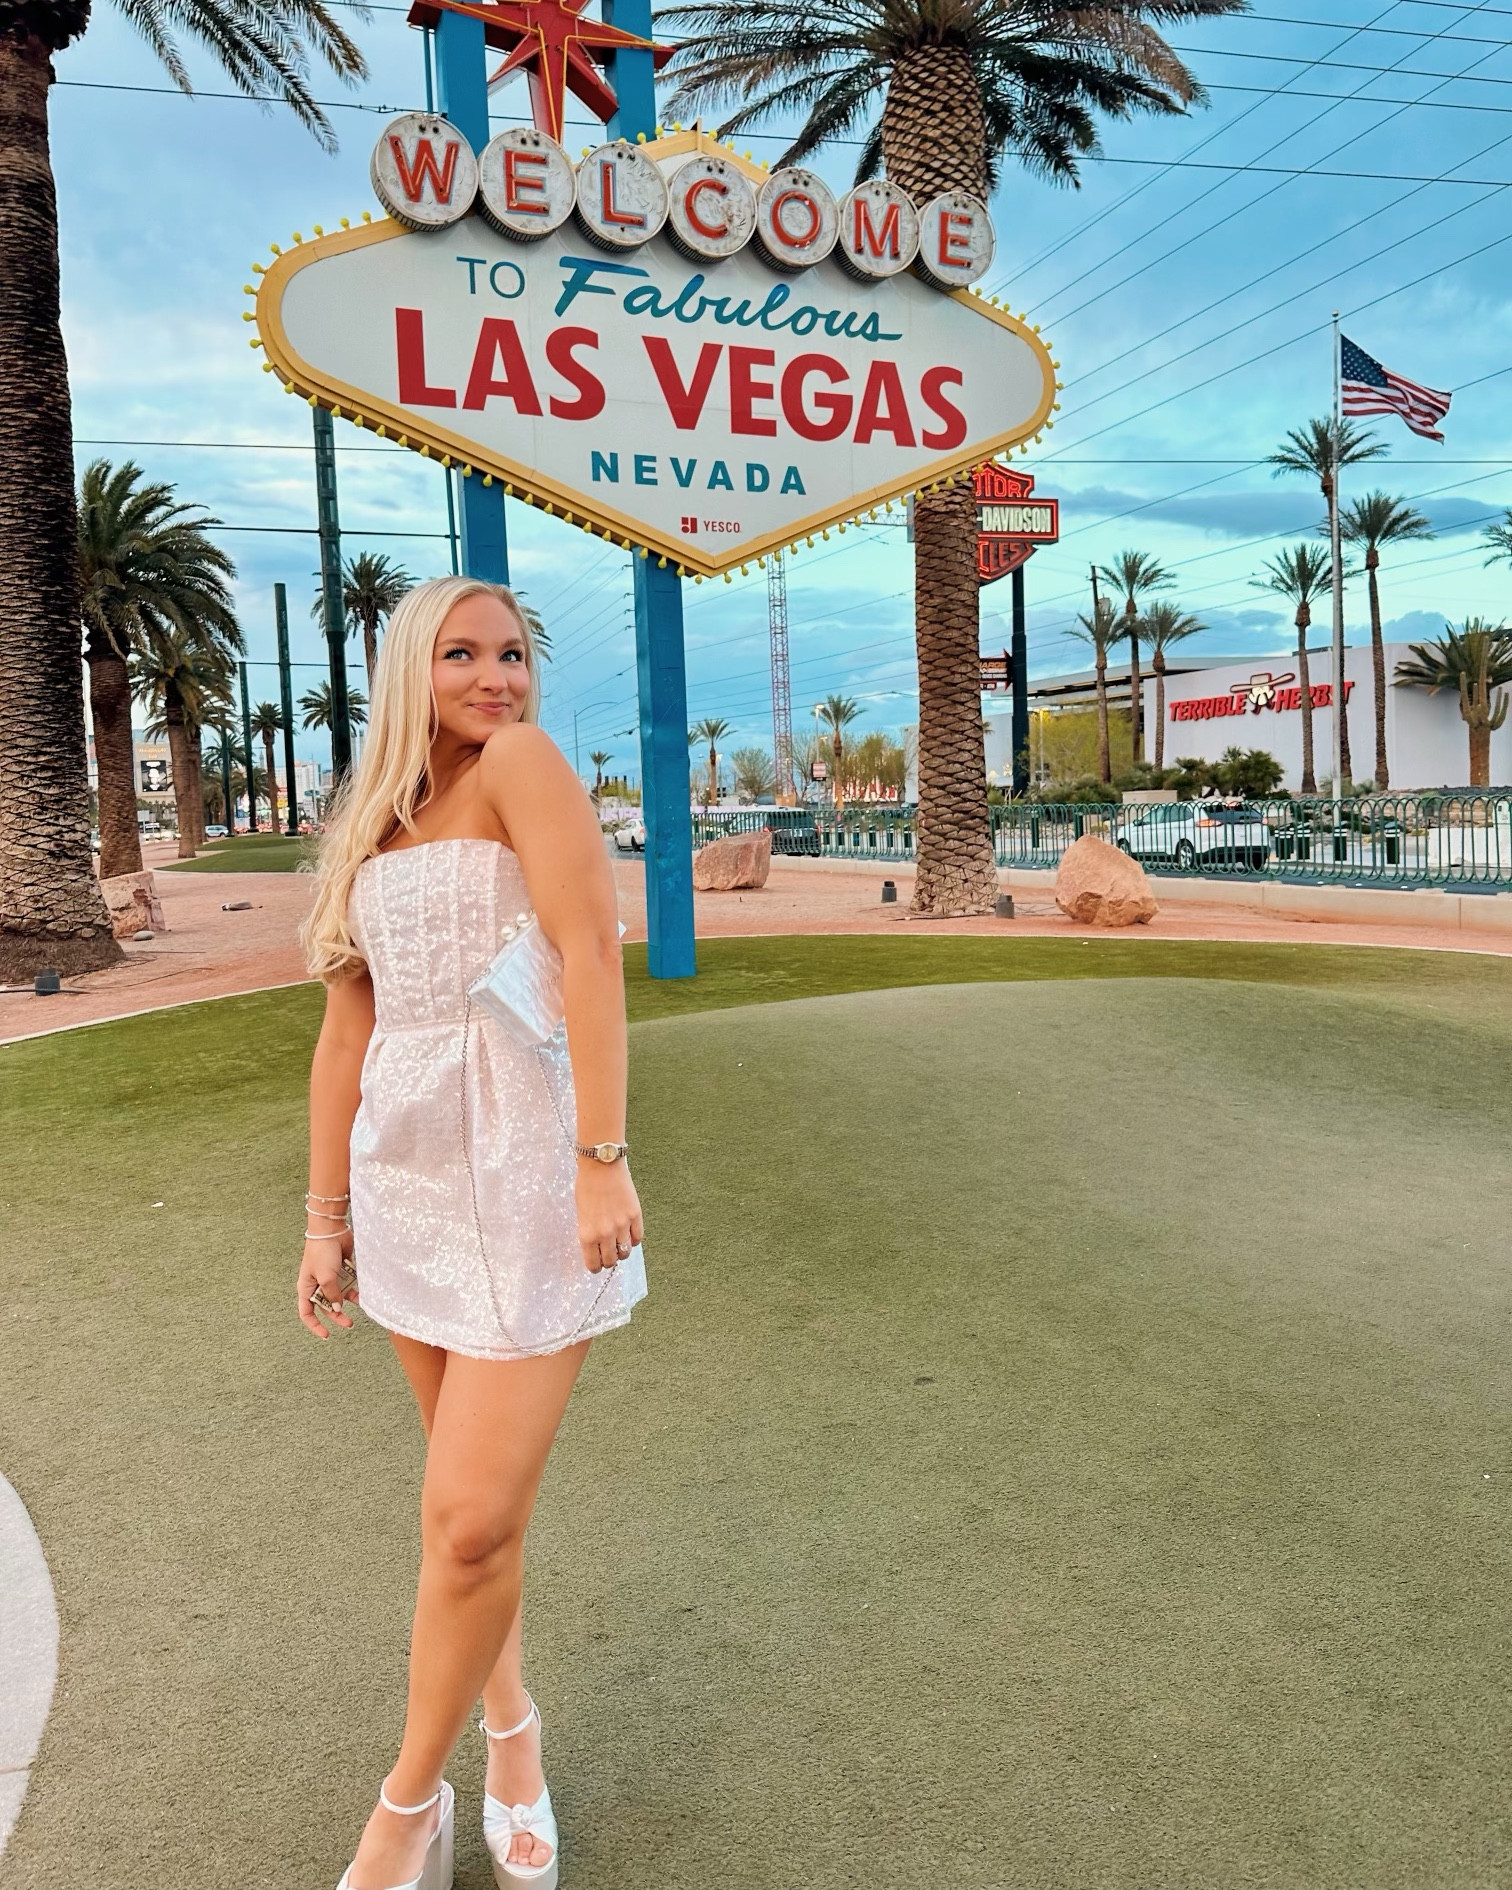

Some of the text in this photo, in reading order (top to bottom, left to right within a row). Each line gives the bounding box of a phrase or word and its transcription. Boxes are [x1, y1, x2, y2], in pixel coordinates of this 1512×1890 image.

[388, 134, 972, 269] WELCOME
[456, 256, 902, 342] TO Fabulous
[395, 307, 967, 450] LAS VEGAS
[591, 451, 806, 495] NEVADA
[703, 520, 741, 533] YESCO
[1169, 693, 1247, 721] TERRIBLE
